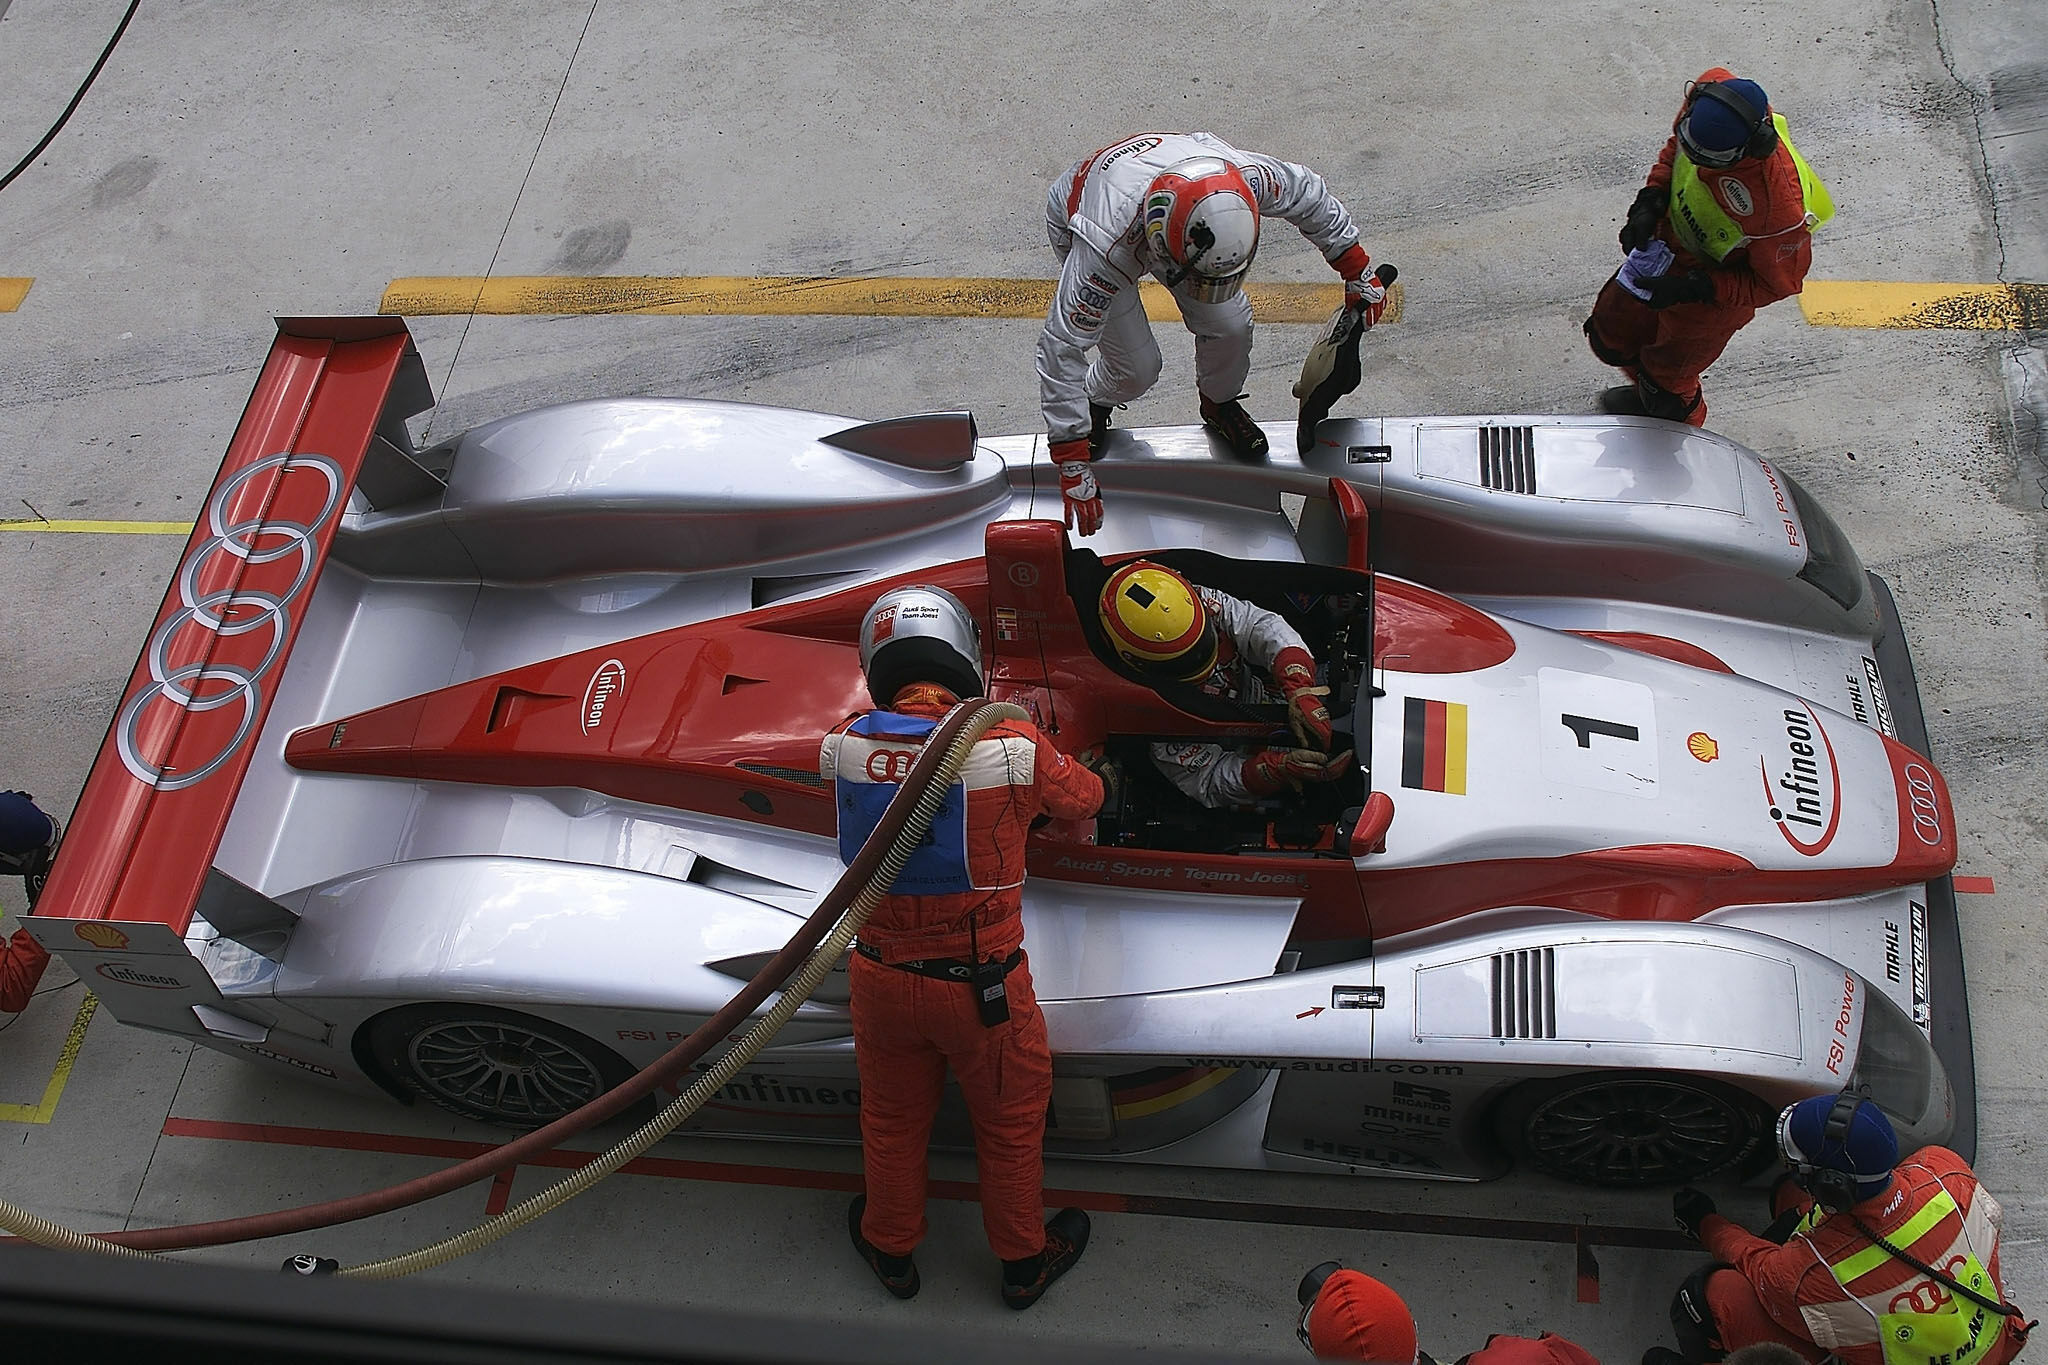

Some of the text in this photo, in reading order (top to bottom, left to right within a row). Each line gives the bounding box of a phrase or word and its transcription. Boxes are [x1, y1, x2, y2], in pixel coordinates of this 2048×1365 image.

[1758, 457, 1801, 548] FSI Power
[902, 612, 919, 620] Team
[920, 605, 940, 614] Sport
[586, 670, 619, 728] Infineon
[1561, 713, 1640, 748] 1
[1779, 708, 1823, 828] Infineon
[1053, 856, 1308, 885] Audi Sport Team Joest
[1884, 919, 1901, 984] MAHLE
[1911, 905, 1926, 1000] MICHELIN
[107, 966, 181, 986] Infineon
[615, 1029, 657, 1042] FSI
[1825, 971, 1857, 1077] FSI Power
[1185, 1056, 1466, 1077] www.audi.com
[1363, 1104, 1453, 1129] MAHLE
[1391, 1096, 1452, 1112] RICARDO
[1303, 1137, 1445, 1170] HELIX
